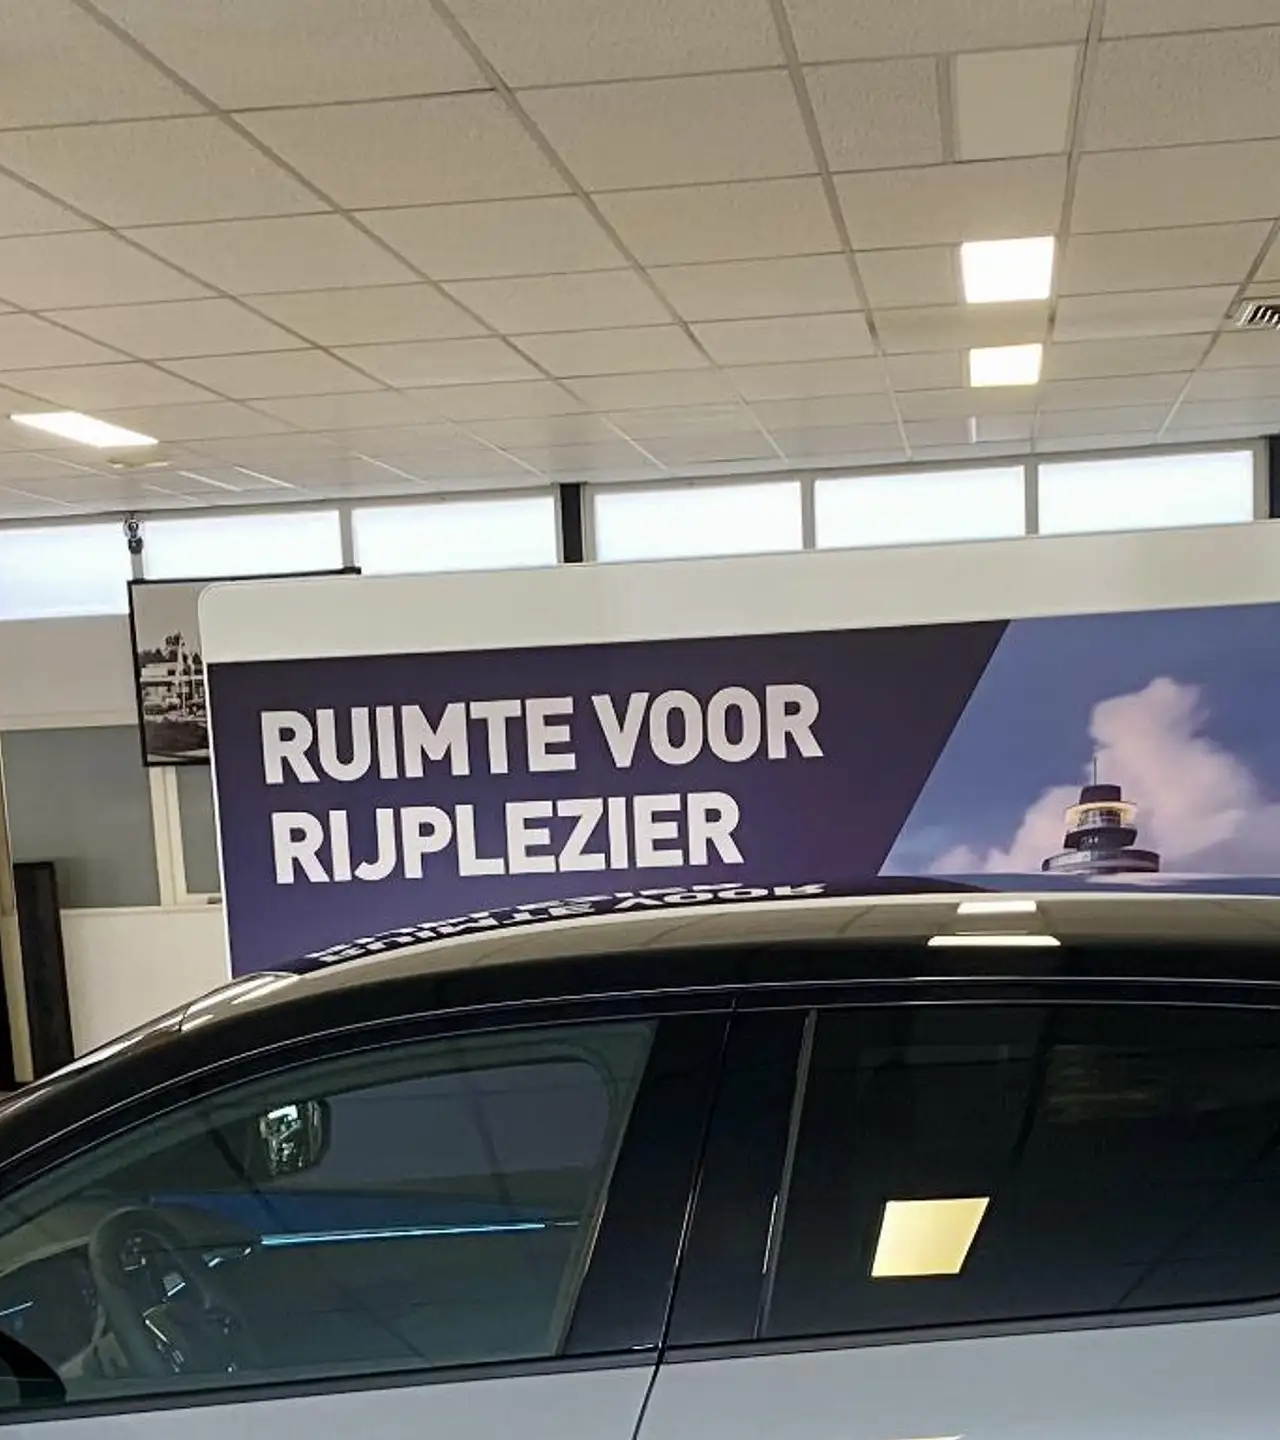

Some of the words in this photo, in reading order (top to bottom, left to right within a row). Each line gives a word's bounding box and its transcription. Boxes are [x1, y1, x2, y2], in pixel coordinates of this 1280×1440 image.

[260, 695, 577, 785] RUIMTE
[591, 684, 824, 769] VOOR
[270, 790, 746, 885] RIJPLEZIER
